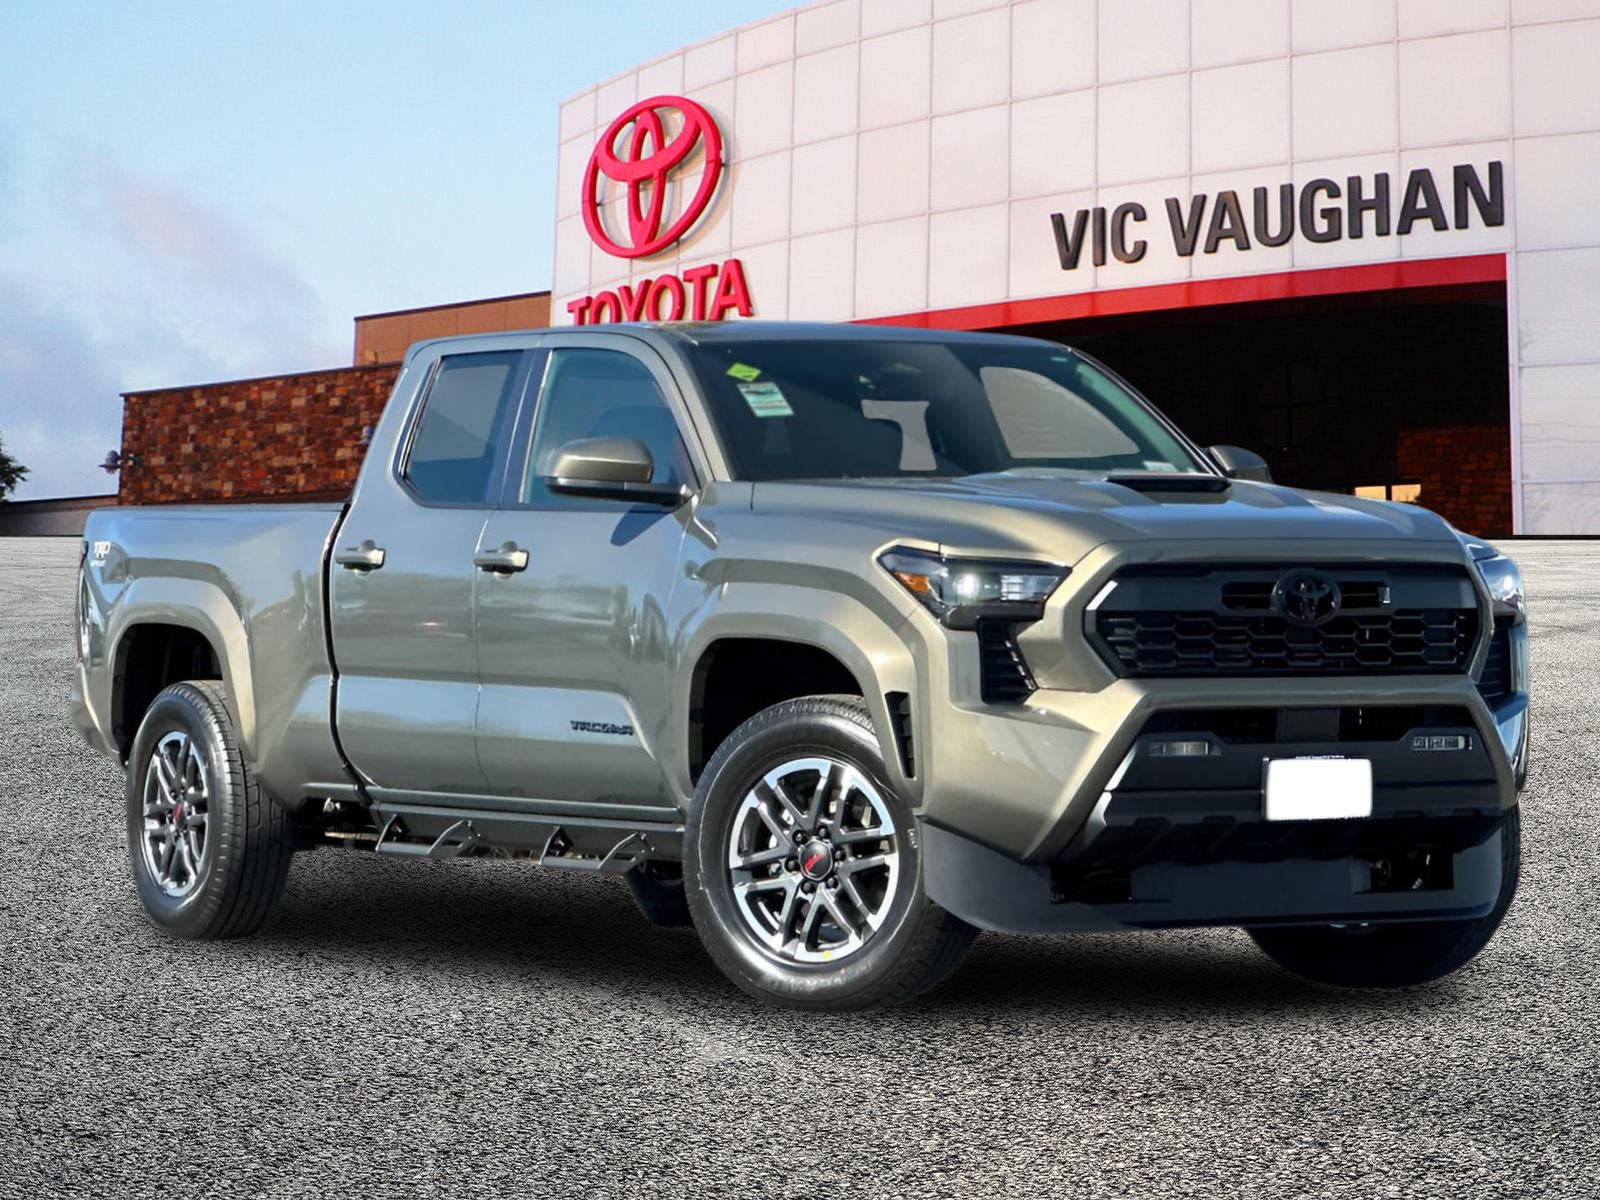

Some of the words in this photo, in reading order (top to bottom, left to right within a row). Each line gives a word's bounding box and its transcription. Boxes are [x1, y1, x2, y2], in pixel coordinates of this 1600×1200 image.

[1050, 201, 1148, 271] VIC
[1164, 160, 1506, 258] VAUGHAN
[567, 258, 754, 326] TOYOTA
